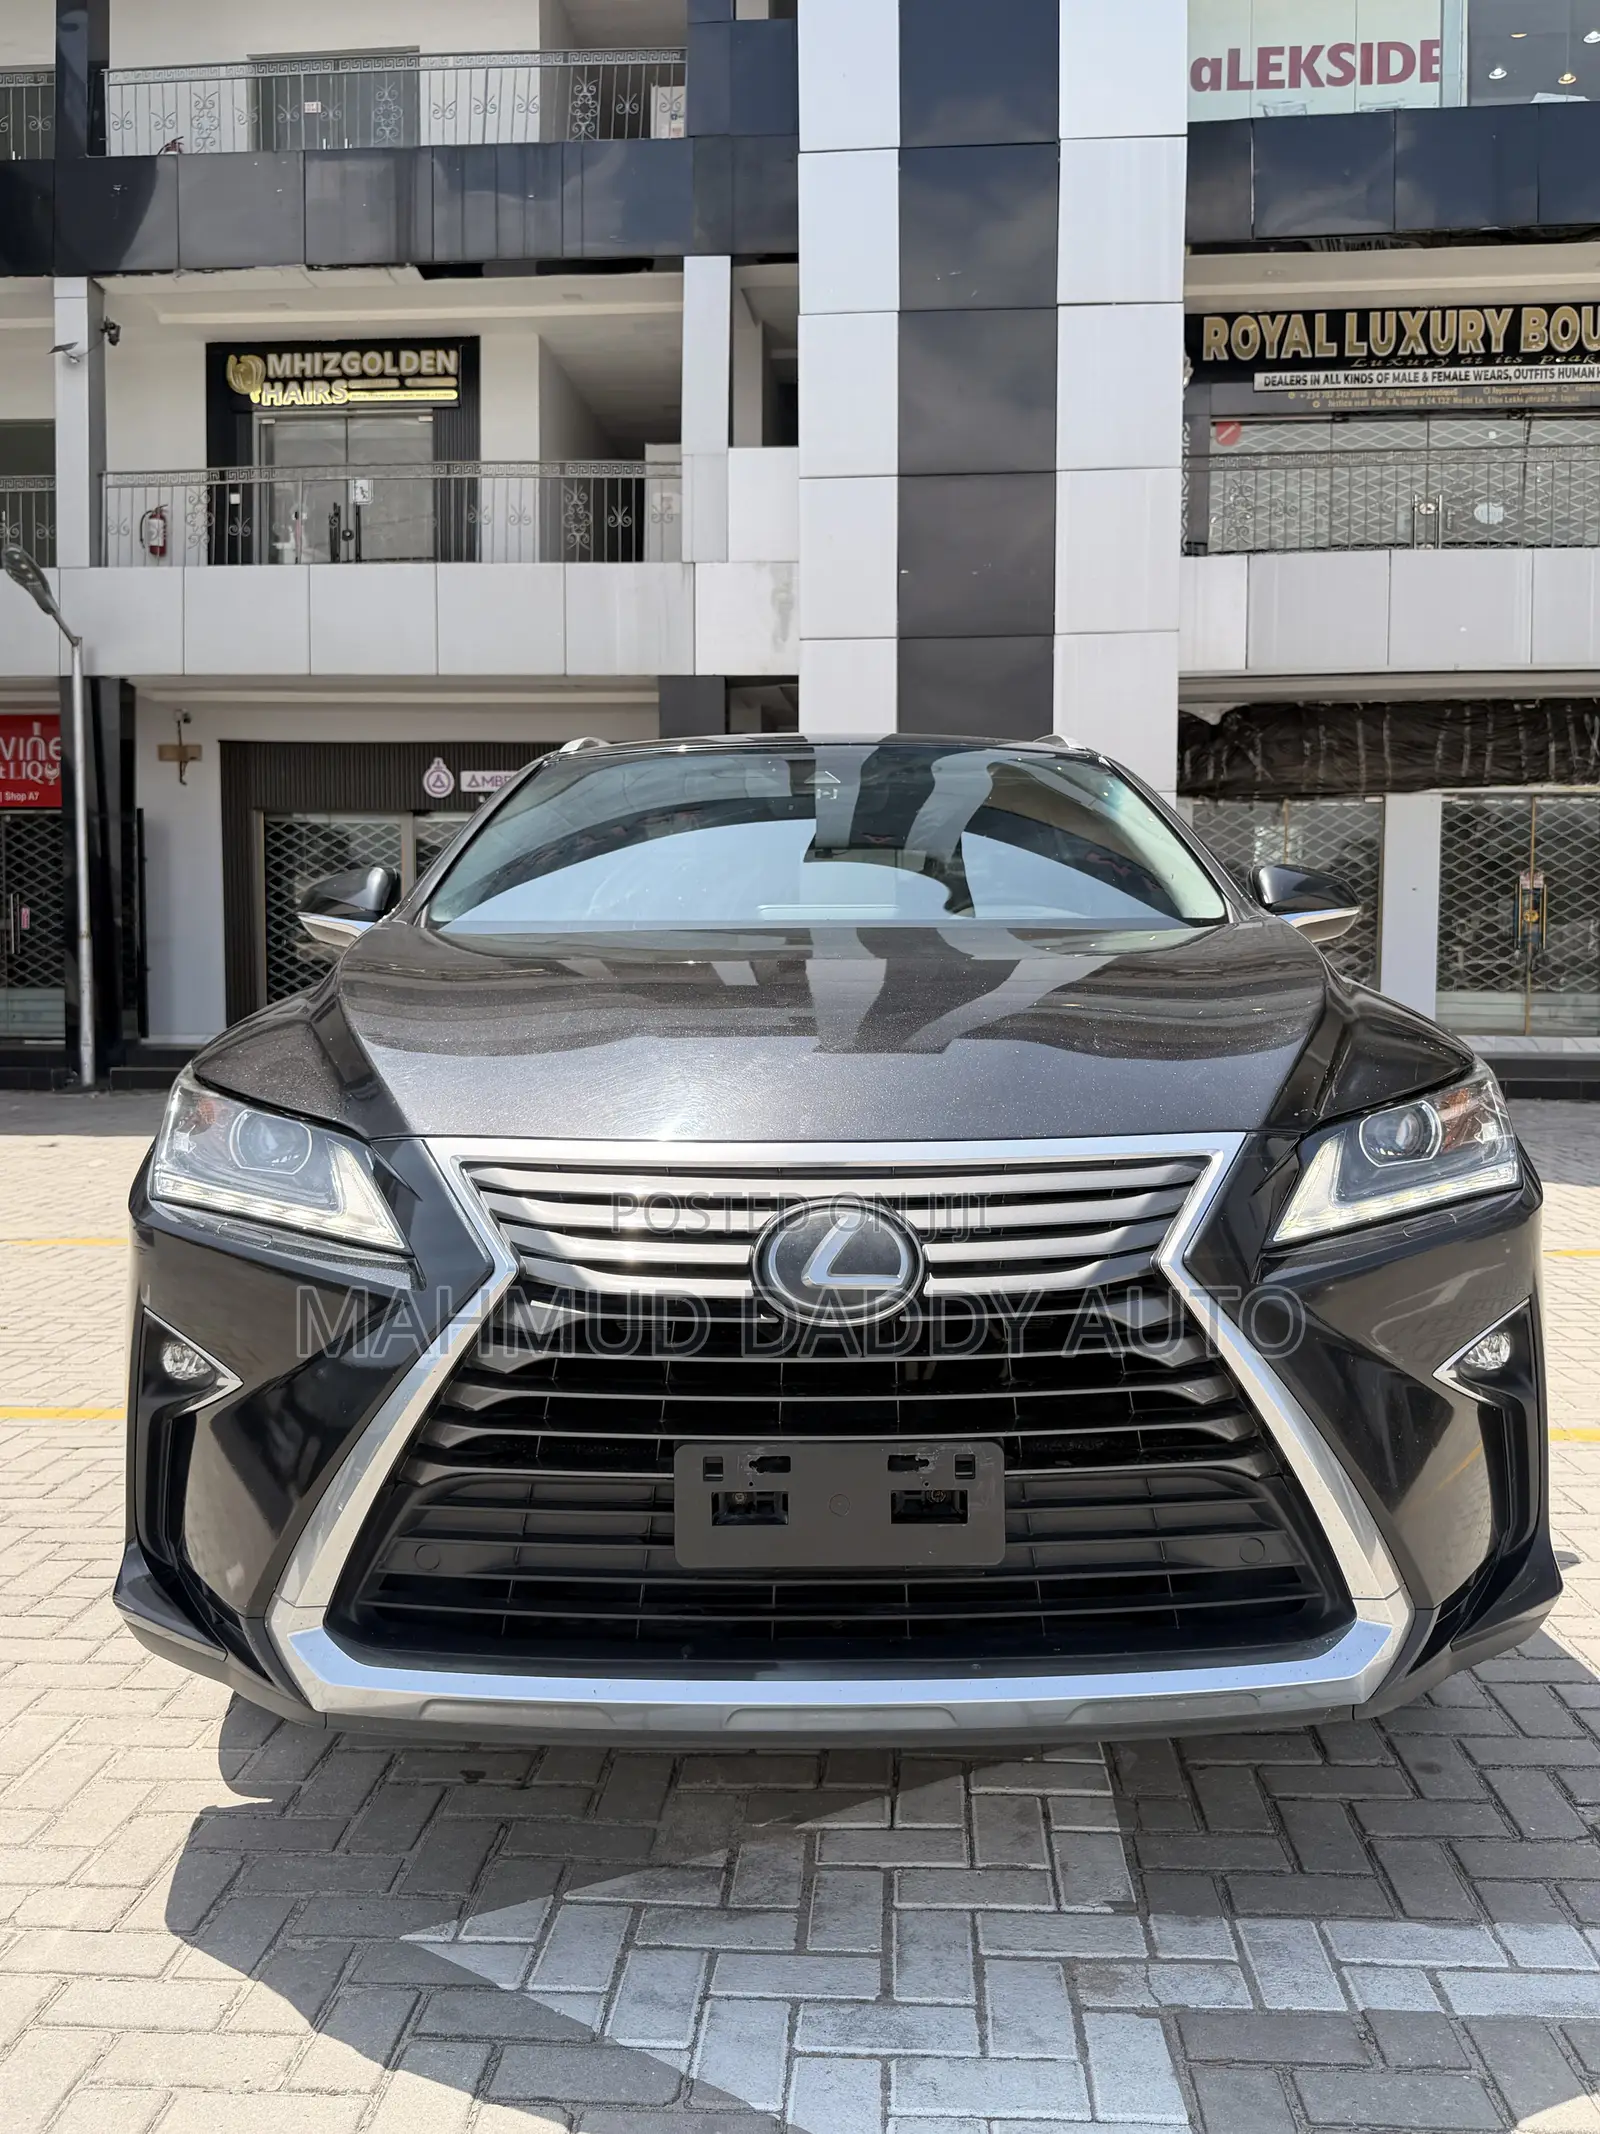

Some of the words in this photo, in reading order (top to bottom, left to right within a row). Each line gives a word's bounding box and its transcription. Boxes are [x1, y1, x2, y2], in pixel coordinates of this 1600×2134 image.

[1202, 313, 1338, 361] ROYAL
[1344, 307, 1514, 357] LUXURY
[1519, 305, 1600, 353] BOU
[267, 350, 459, 378] MHIZGOLDEN
[1460, 354, 1484, 364] at
[1494, 353, 1524, 364] its
[1263, 374, 1308, 387] DEALERS
[1310, 374, 1320, 385] IN
[1322, 373, 1341, 385] ALL
[1343, 372, 1373, 384] KINDS
[1376, 371, 1390, 384] OF
[1392, 371, 1419, 383] MALE
[1421, 371, 1429, 383] &
[1431, 369, 1471, 382] FEMALE
[1472, 368, 1512, 382] WEARS,
[1513, 367, 1555, 380] OUTFITS
[1557, 366, 1596, 379] HUMAN
[261, 378, 349, 406] HAIRS
[5, 791, 27, 802] Shop
[28, 791, 40, 801] A7
